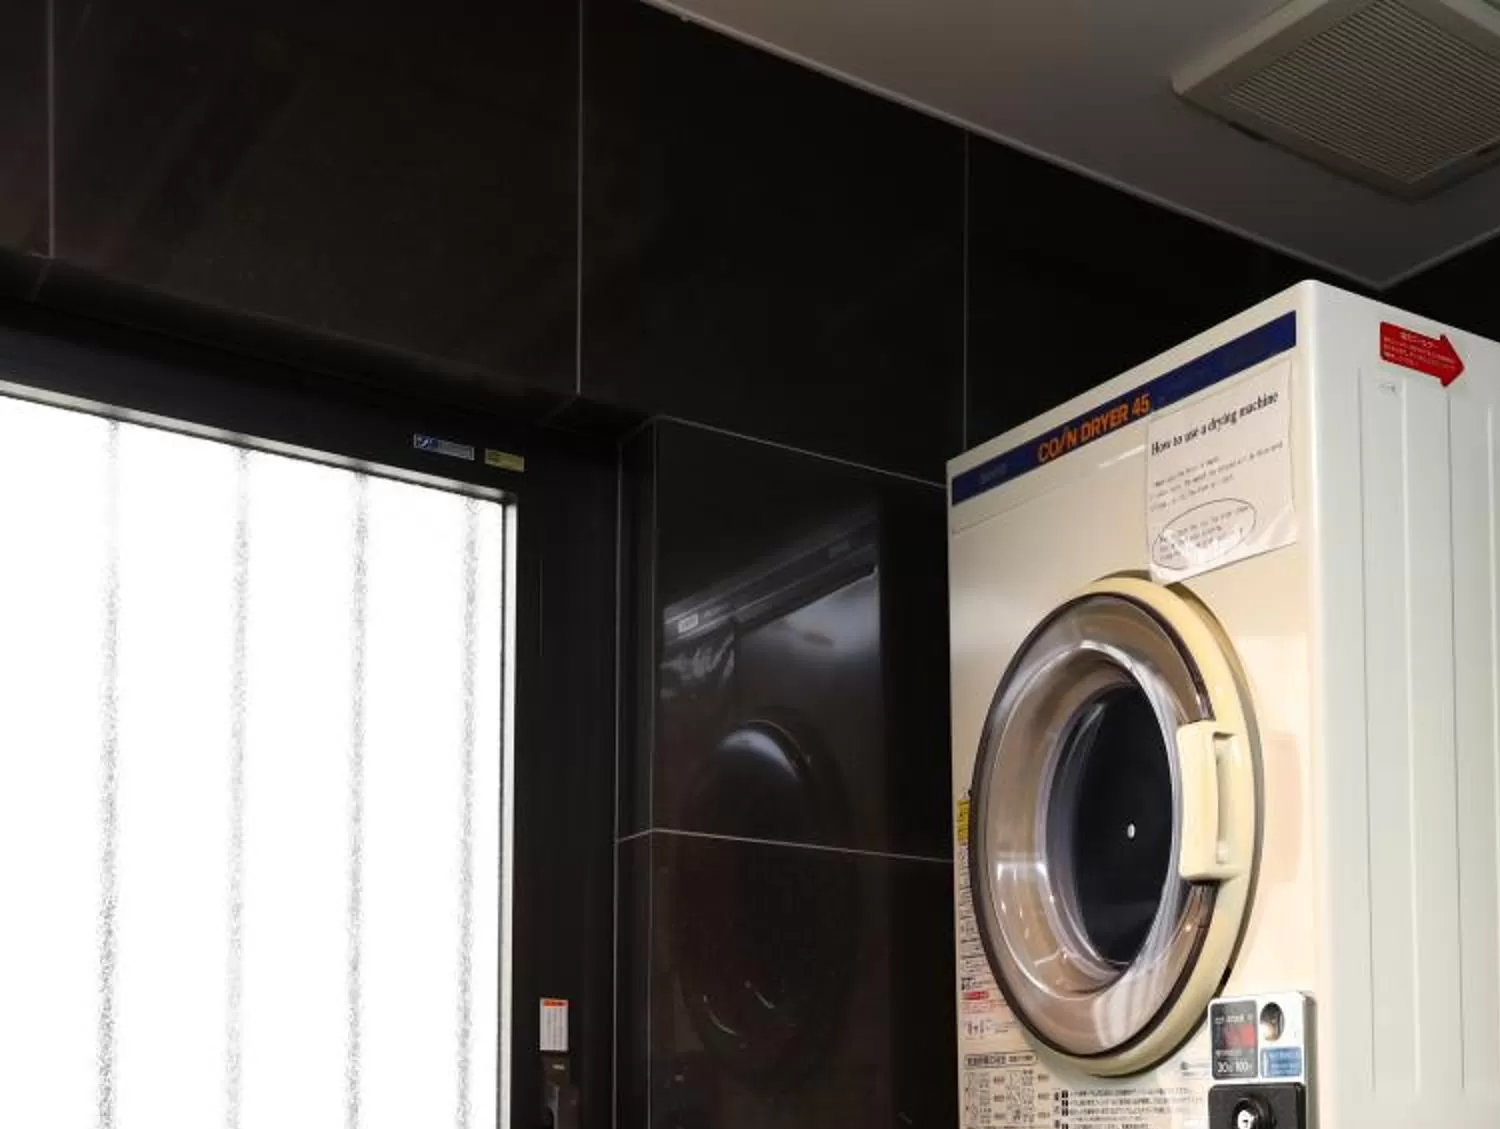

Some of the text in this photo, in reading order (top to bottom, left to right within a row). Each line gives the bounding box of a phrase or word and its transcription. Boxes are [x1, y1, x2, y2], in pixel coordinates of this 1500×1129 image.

[1080, 403, 1129, 441] DRYER
[1151, 441, 1171, 456] How
[1173, 435, 1182, 446] to
[1208, 411, 1237, 433] drying
